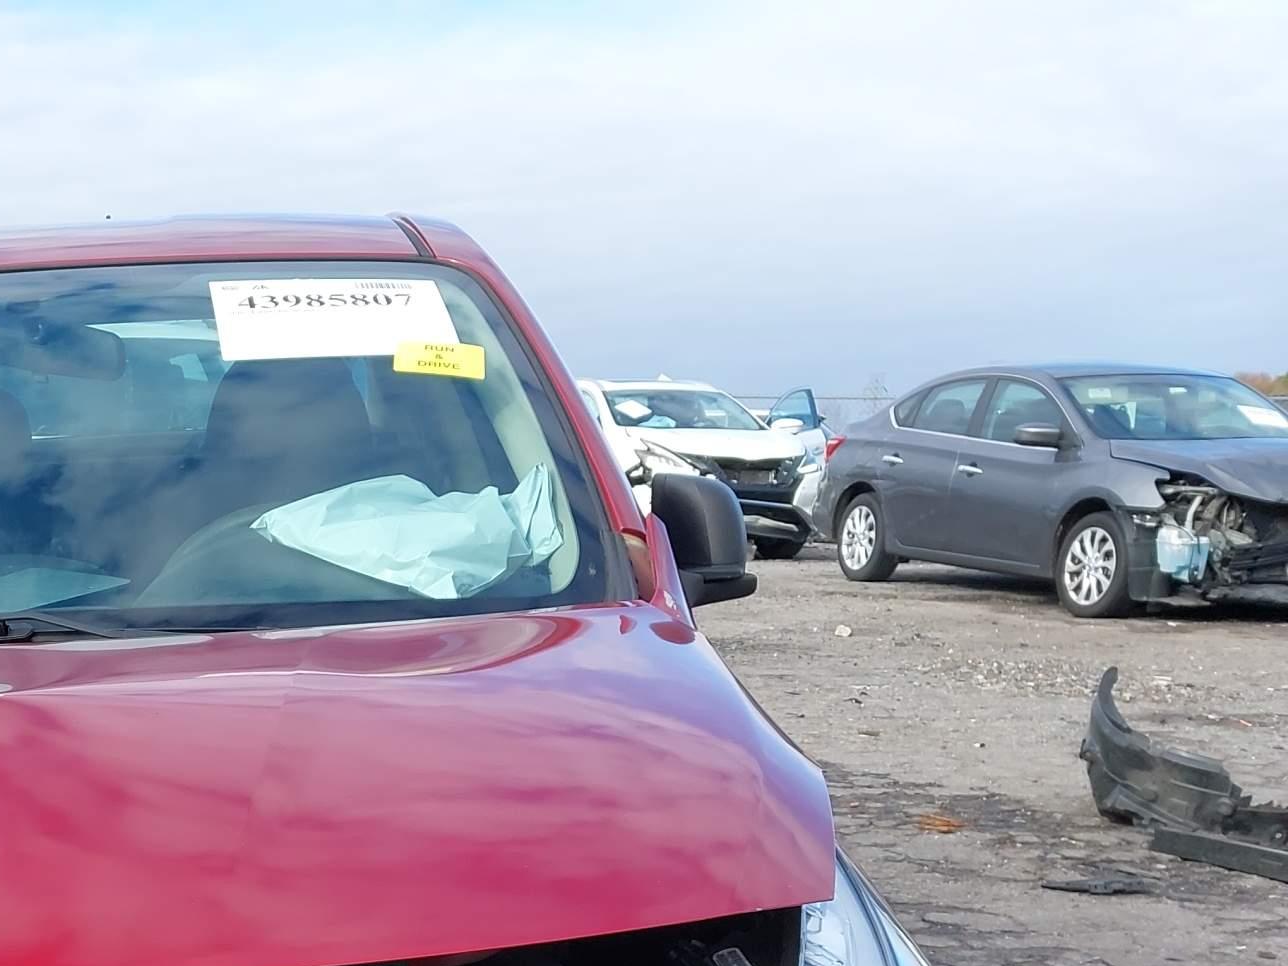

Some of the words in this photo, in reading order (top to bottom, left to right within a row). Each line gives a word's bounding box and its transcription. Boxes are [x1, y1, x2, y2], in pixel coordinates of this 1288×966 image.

[238, 293, 412, 309] 43985807
[424, 344, 454, 352] RUN
[417, 360, 461, 370] DRIVE
